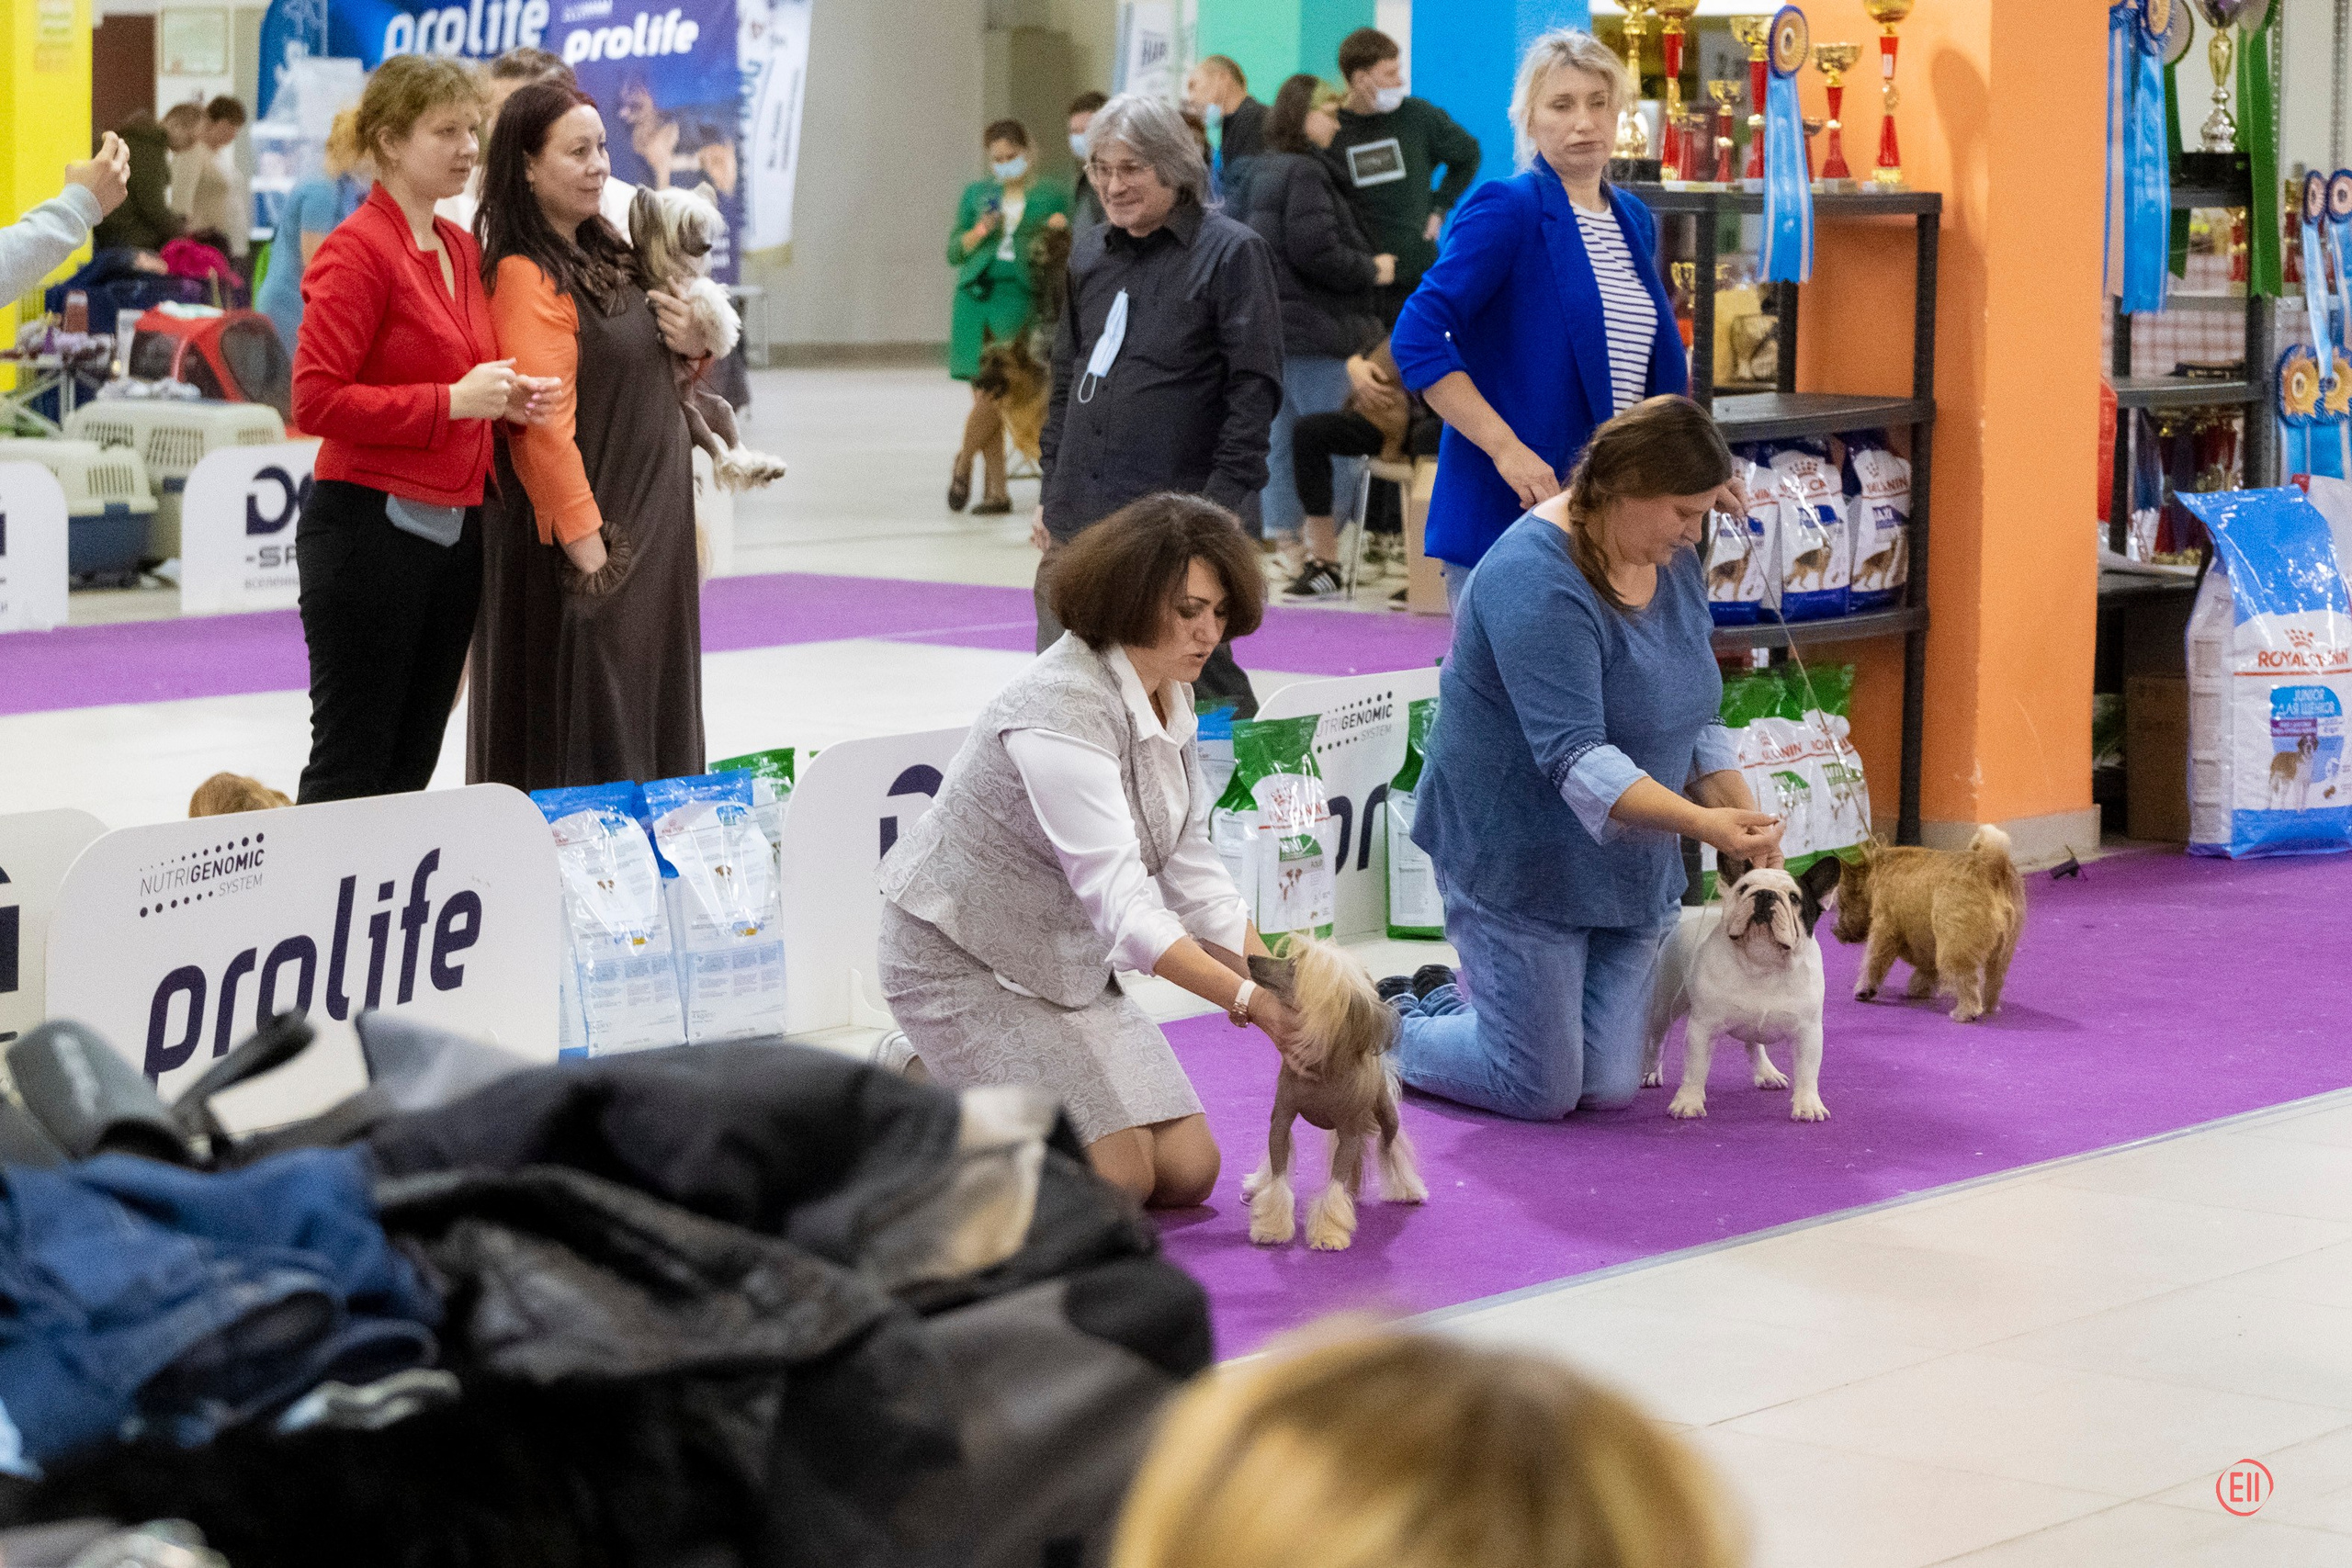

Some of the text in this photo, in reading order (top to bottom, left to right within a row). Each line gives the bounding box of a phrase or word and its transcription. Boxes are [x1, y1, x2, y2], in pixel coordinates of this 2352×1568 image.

[382, 0, 549, 62] prolife
[563, 8, 700, 65] prolife
[2257, 650, 2308, 668] ROYAL
[1361, 723, 1392, 742] SYSTEM
[140, 848, 266, 897] NUTRIGENOMIC
[219, 873, 264, 897] SYSTEM
[143, 847, 482, 1091] prolife
